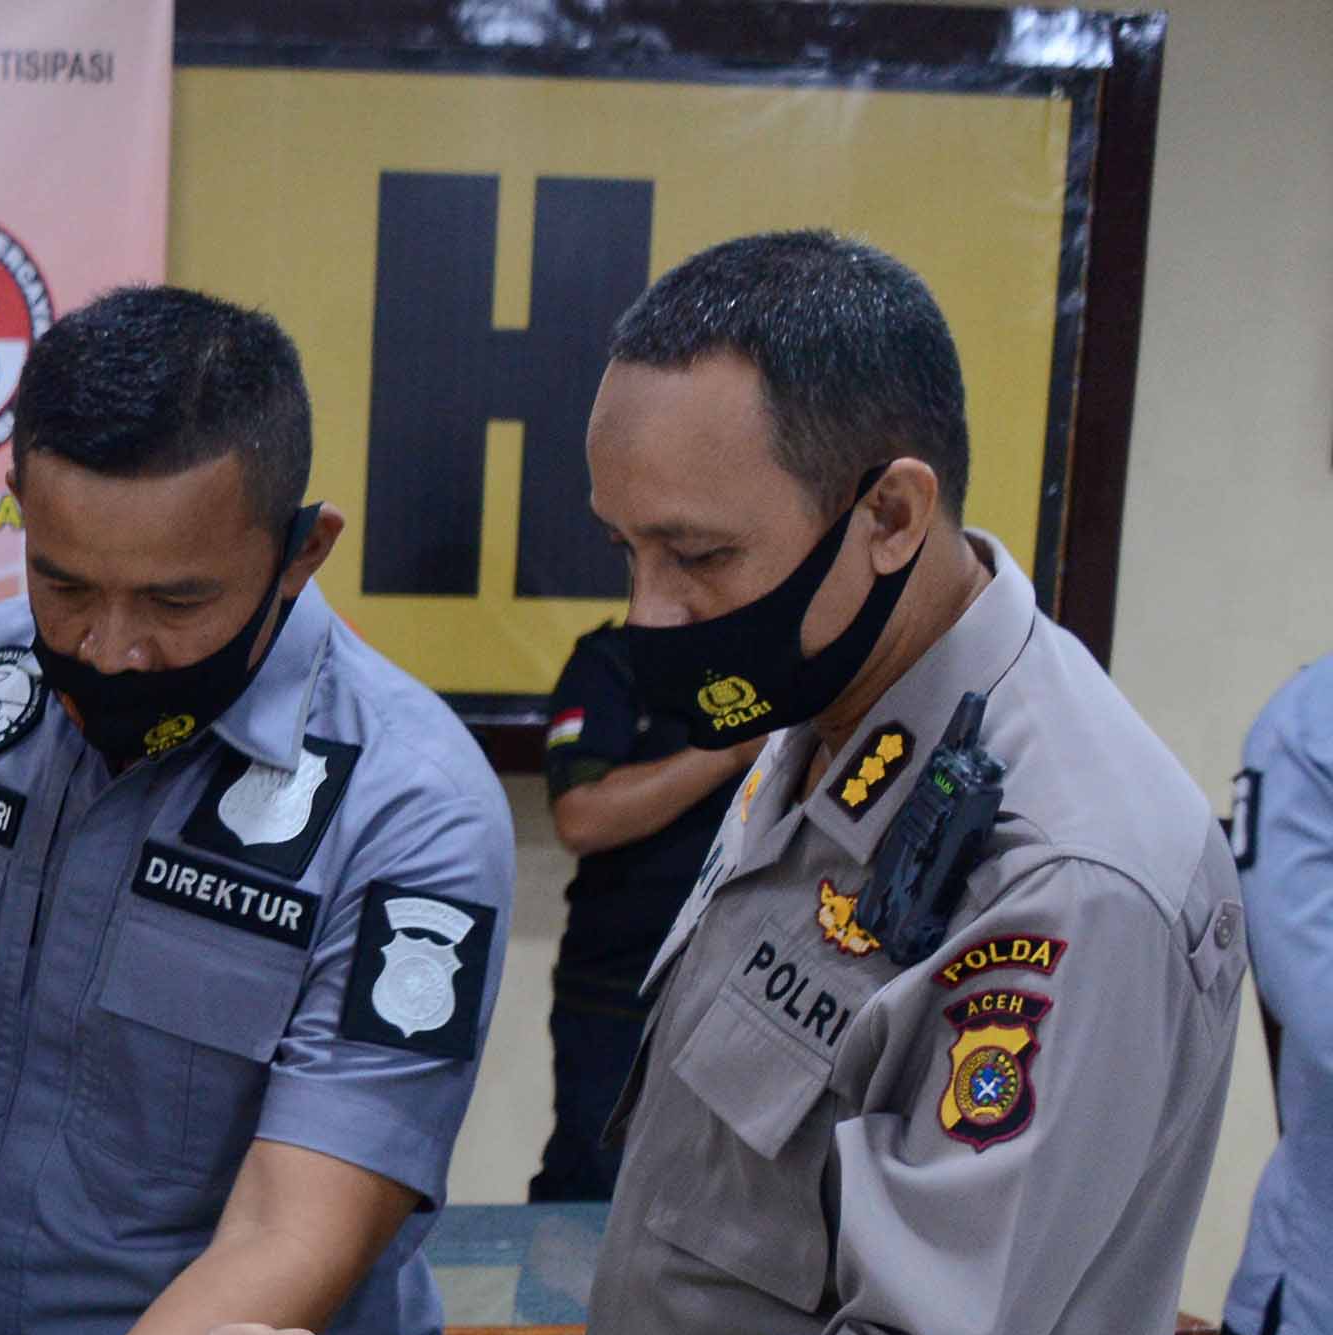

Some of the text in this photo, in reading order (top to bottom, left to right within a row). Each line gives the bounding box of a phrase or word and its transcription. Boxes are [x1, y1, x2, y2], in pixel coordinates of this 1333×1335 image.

[712, 700, 773, 731] POLRI
[145, 857, 304, 932] DIREKTUR
[943, 939, 1052, 982] POLDA
[744, 941, 851, 1047] POLRI
[966, 993, 1025, 1016] ACEH
